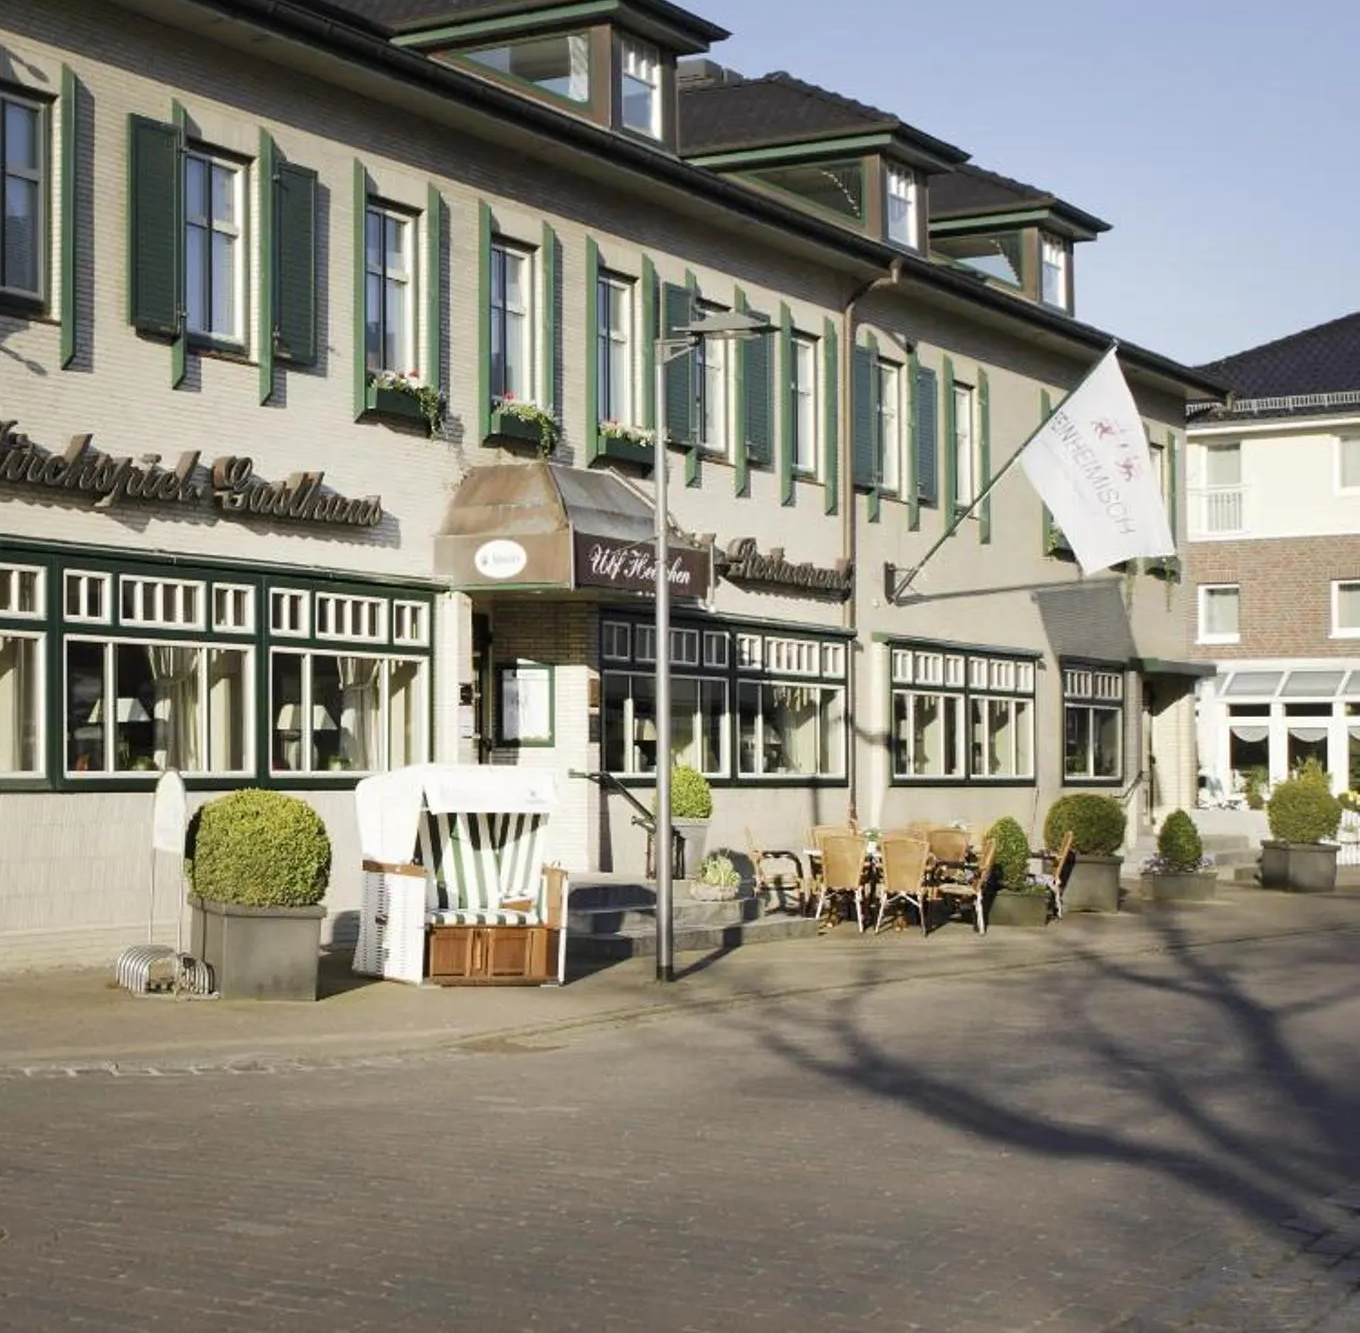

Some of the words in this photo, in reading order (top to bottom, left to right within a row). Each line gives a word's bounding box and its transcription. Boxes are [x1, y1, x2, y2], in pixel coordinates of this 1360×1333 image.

[212, 455, 382, 527] Gasthaus
[1051, 410, 1137, 534] EINHEIMISCH
[623, 549, 691, 585] Heehen
